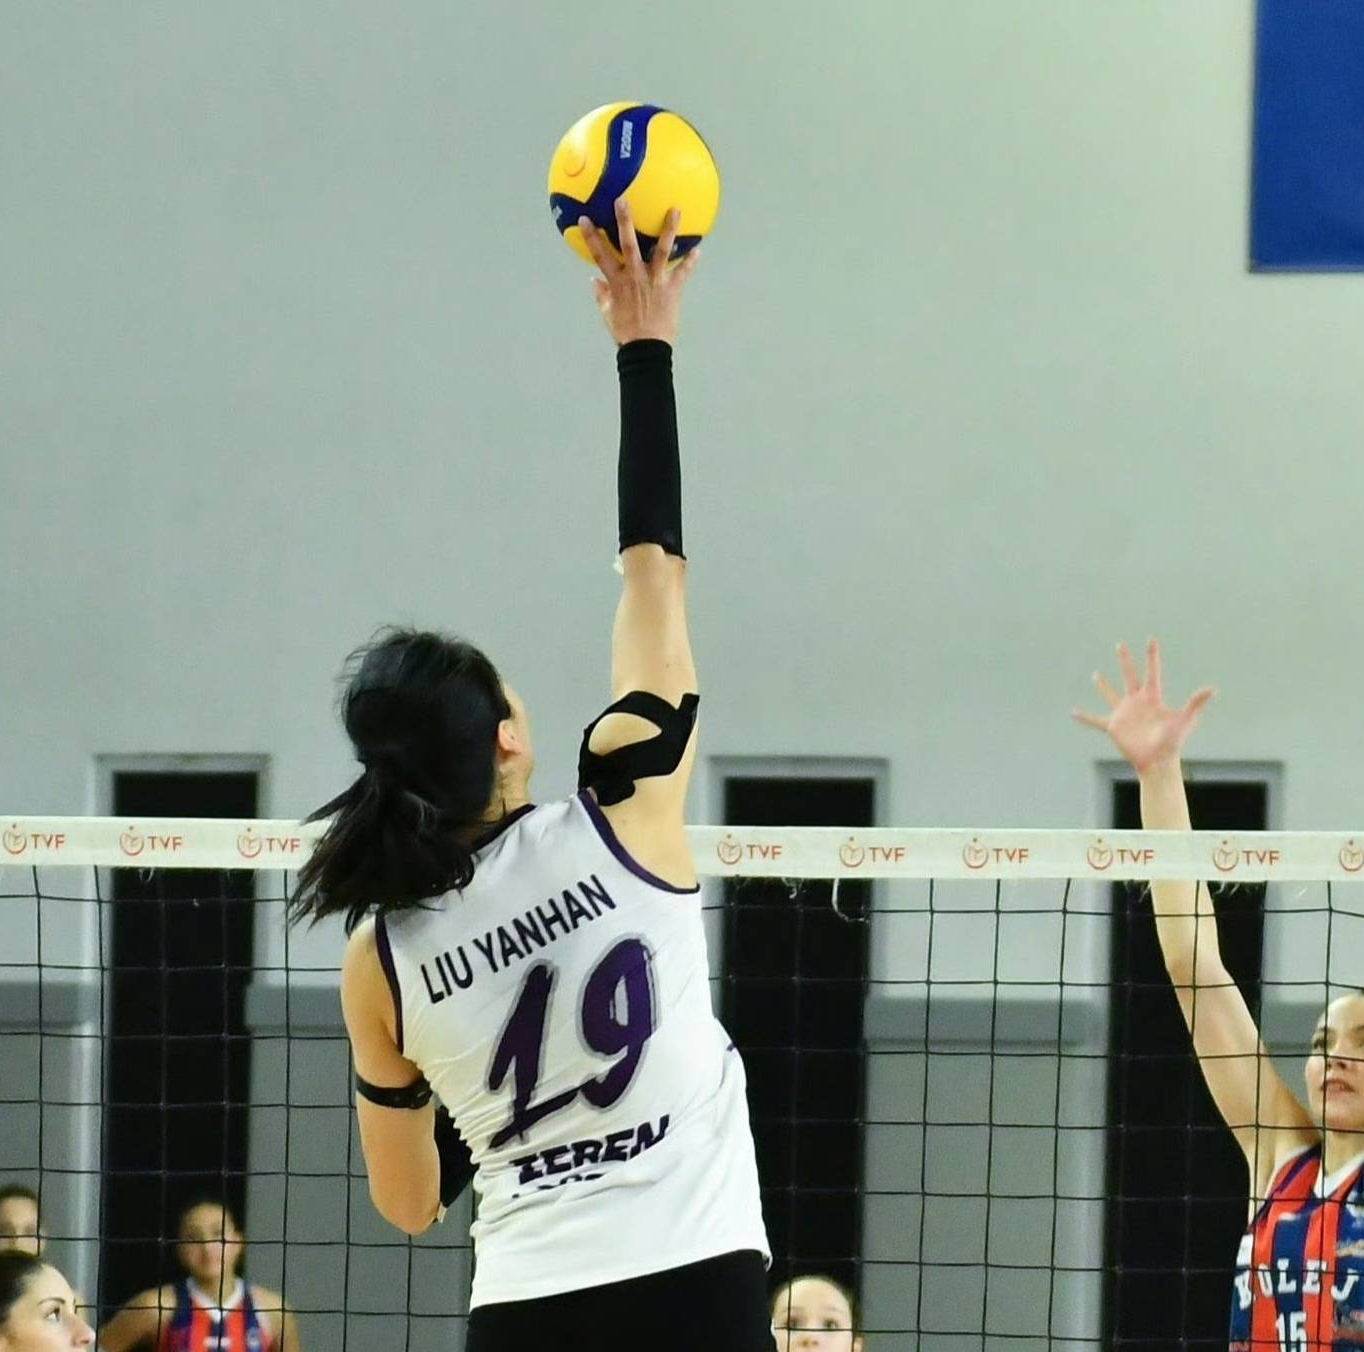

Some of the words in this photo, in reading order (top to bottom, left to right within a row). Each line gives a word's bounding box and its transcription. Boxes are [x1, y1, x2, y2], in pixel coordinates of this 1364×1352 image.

[30, 833, 66, 850] TVF
[146, 835, 183, 852] TVF
[264, 837, 301, 854] TVF
[745, 843, 783, 861] TVF
[868, 846, 906, 863] TVF
[991, 847, 1030, 864] TVF
[1116, 848, 1155, 865] TVF
[1241, 849, 1280, 866] TVF
[420, 945, 474, 1004] LIU
[472, 873, 617, 974] YANHAN
[487, 932, 661, 1150] 19
[1234, 1258, 1361, 1311] KOLEJ
